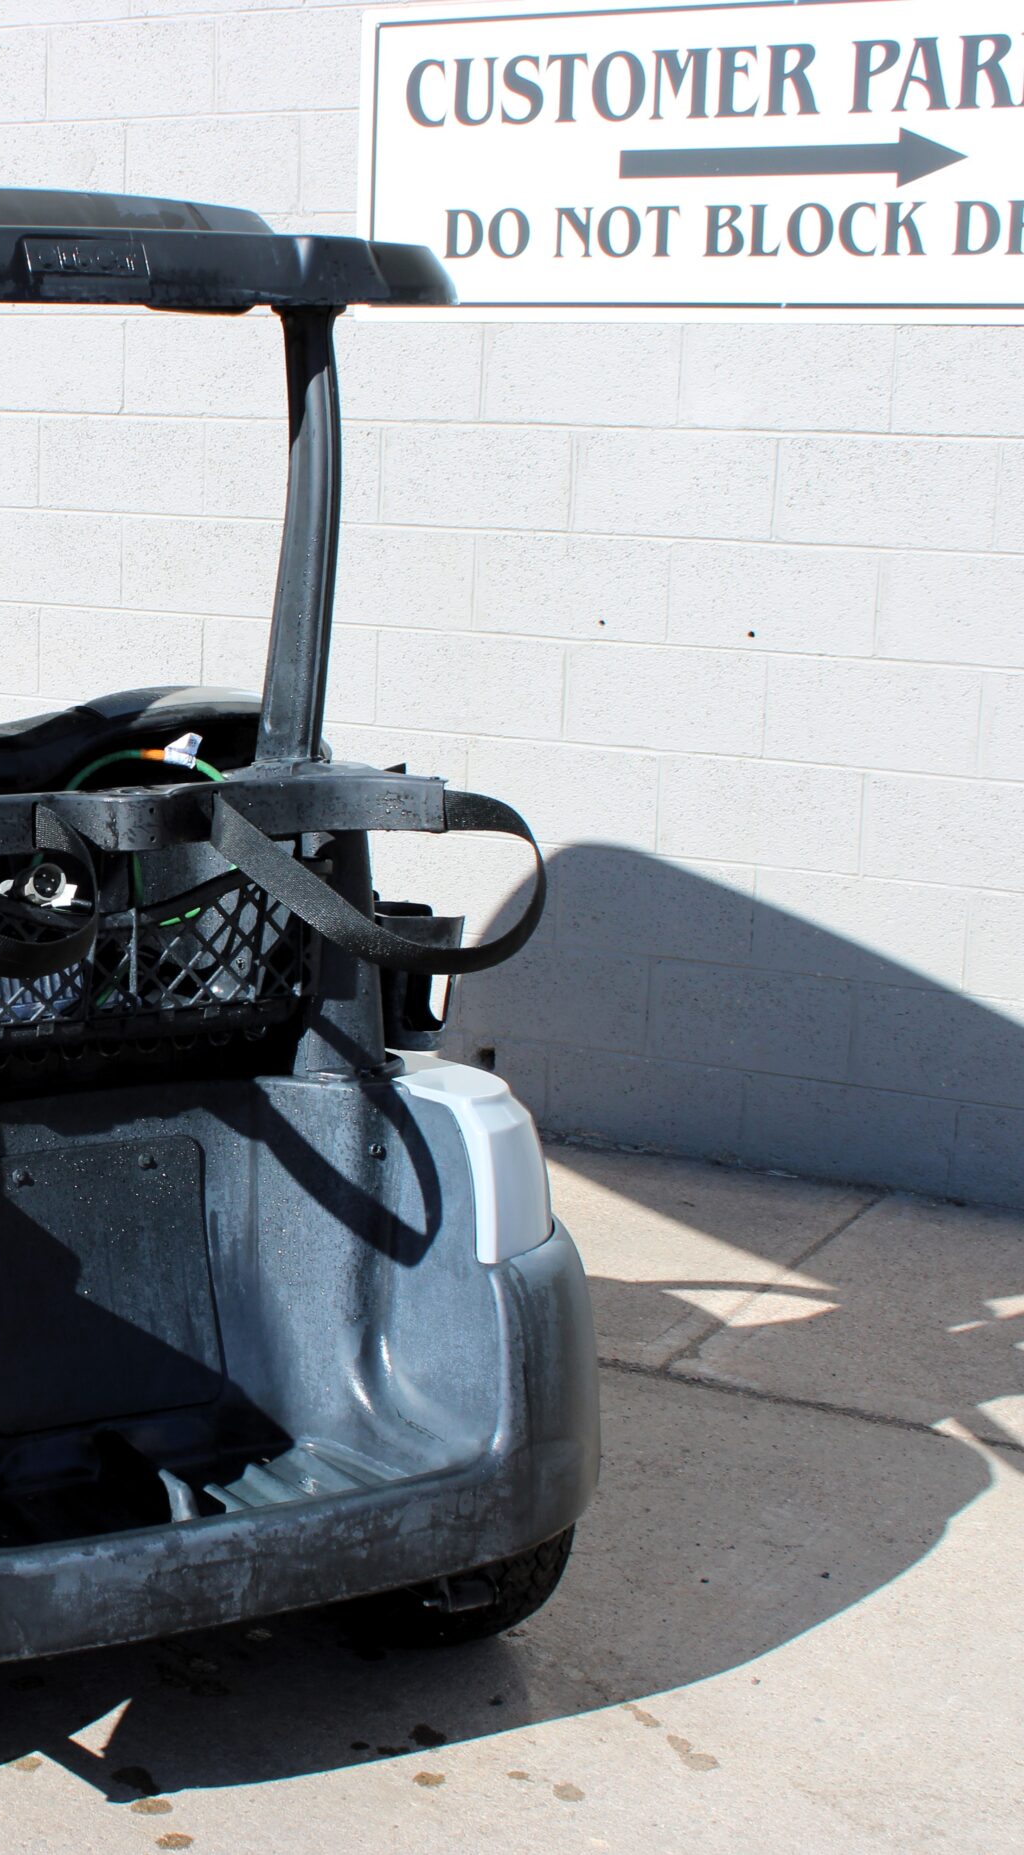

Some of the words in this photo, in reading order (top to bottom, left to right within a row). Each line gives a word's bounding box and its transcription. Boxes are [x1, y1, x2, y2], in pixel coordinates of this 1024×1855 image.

[406, 43, 821, 127] CUSTOMER
[847, 33, 1024, 113] PAR
[444, 207, 531, 259] DO
[553, 205, 681, 258] NOT
[702, 201, 927, 258] BLOCK
